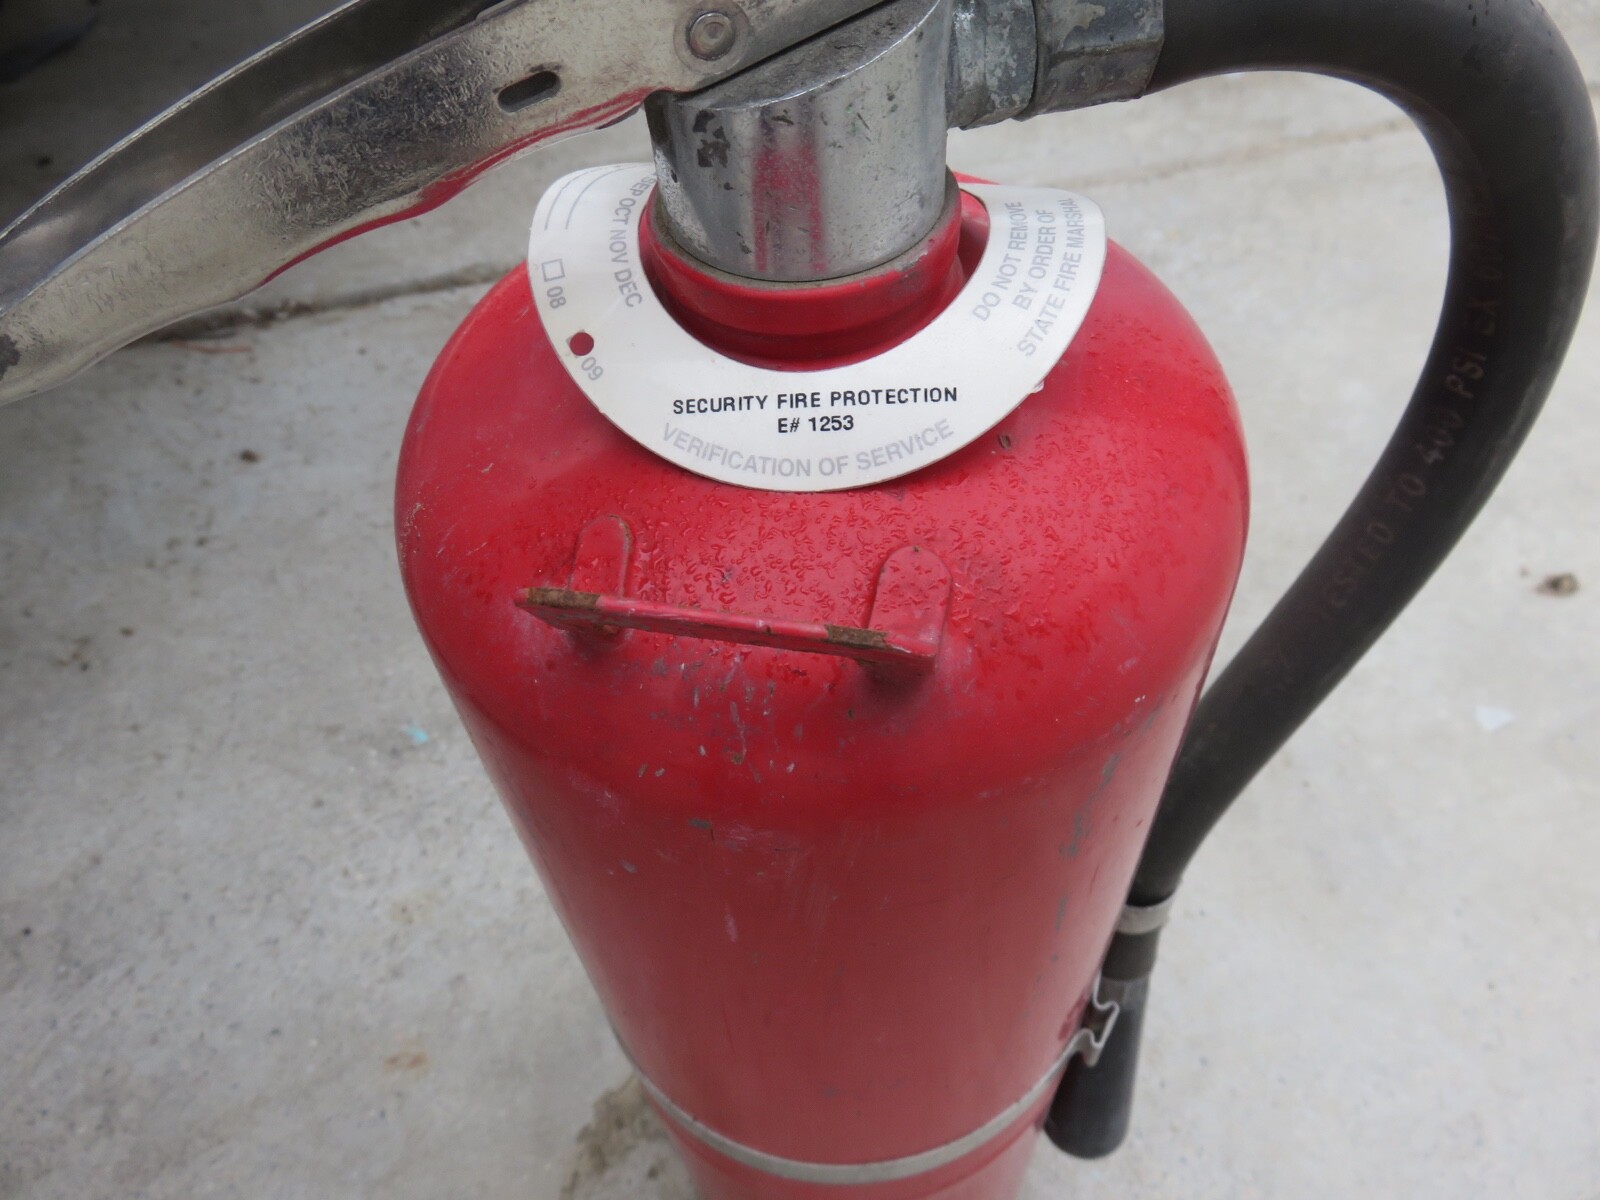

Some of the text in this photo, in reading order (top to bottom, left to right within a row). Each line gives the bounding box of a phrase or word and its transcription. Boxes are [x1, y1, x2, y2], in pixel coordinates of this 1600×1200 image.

[609, 176, 657, 308] SEP OCT NOV DEC
[972, 201, 1028, 322] DO NOT REMOVE
[1012, 209, 1057, 311] BY ORDER OF
[546, 286, 567, 310] 08
[1017, 293, 1066, 357] STATE
[1053, 252, 1082, 292] FIRE
[581, 356, 604, 381] 09
[1445, 346, 1488, 399] PSI
[673, 387, 958, 415] SECURITY FIRE PROTECTION
[777, 415, 855, 434] E# 1253
[663, 419, 955, 477] VERIFICATION OF SERVICE
